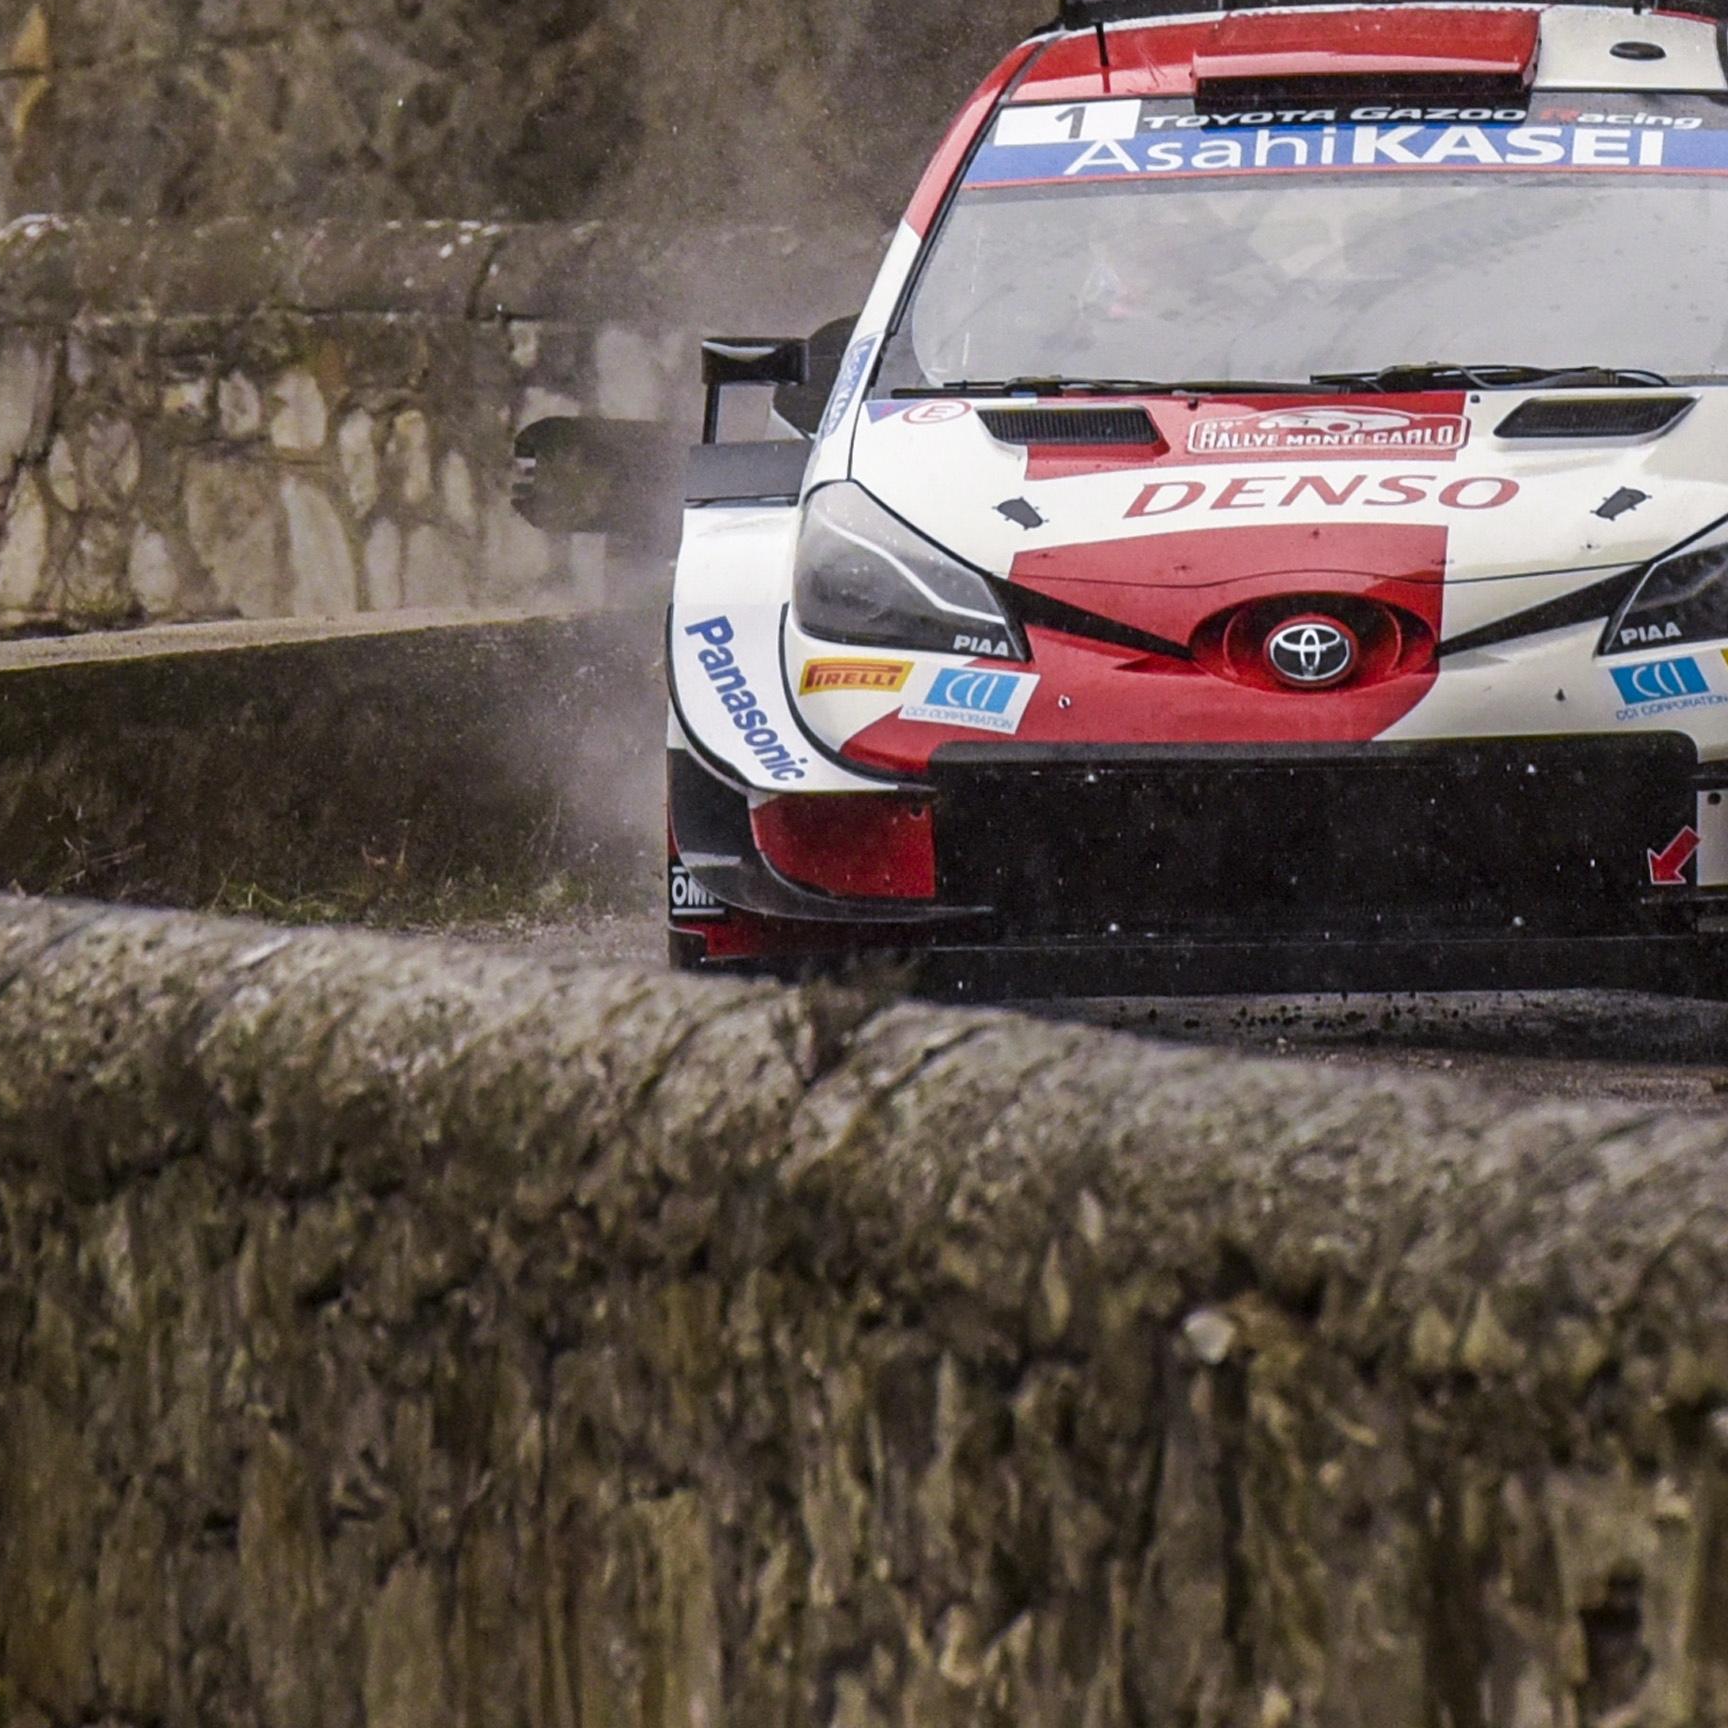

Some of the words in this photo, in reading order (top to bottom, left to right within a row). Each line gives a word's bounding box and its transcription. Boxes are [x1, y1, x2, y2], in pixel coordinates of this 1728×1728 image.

[1054, 106, 1086, 139] 1
[1144, 109, 1335, 129] TOYOTA
[1350, 106, 1526, 122] GAZOO
[1540, 107, 1703, 129] Racing
[1200, 430, 1280, 449] RALLYE
[1122, 474, 1520, 519] DENSO
[952, 634, 1009, 657] PIAA
[1620, 622, 1683, 646] PIAA
[804, 664, 904, 689] PIRELLI
[684, 615, 809, 781] Panasonic
[671, 875, 715, 906] OM
